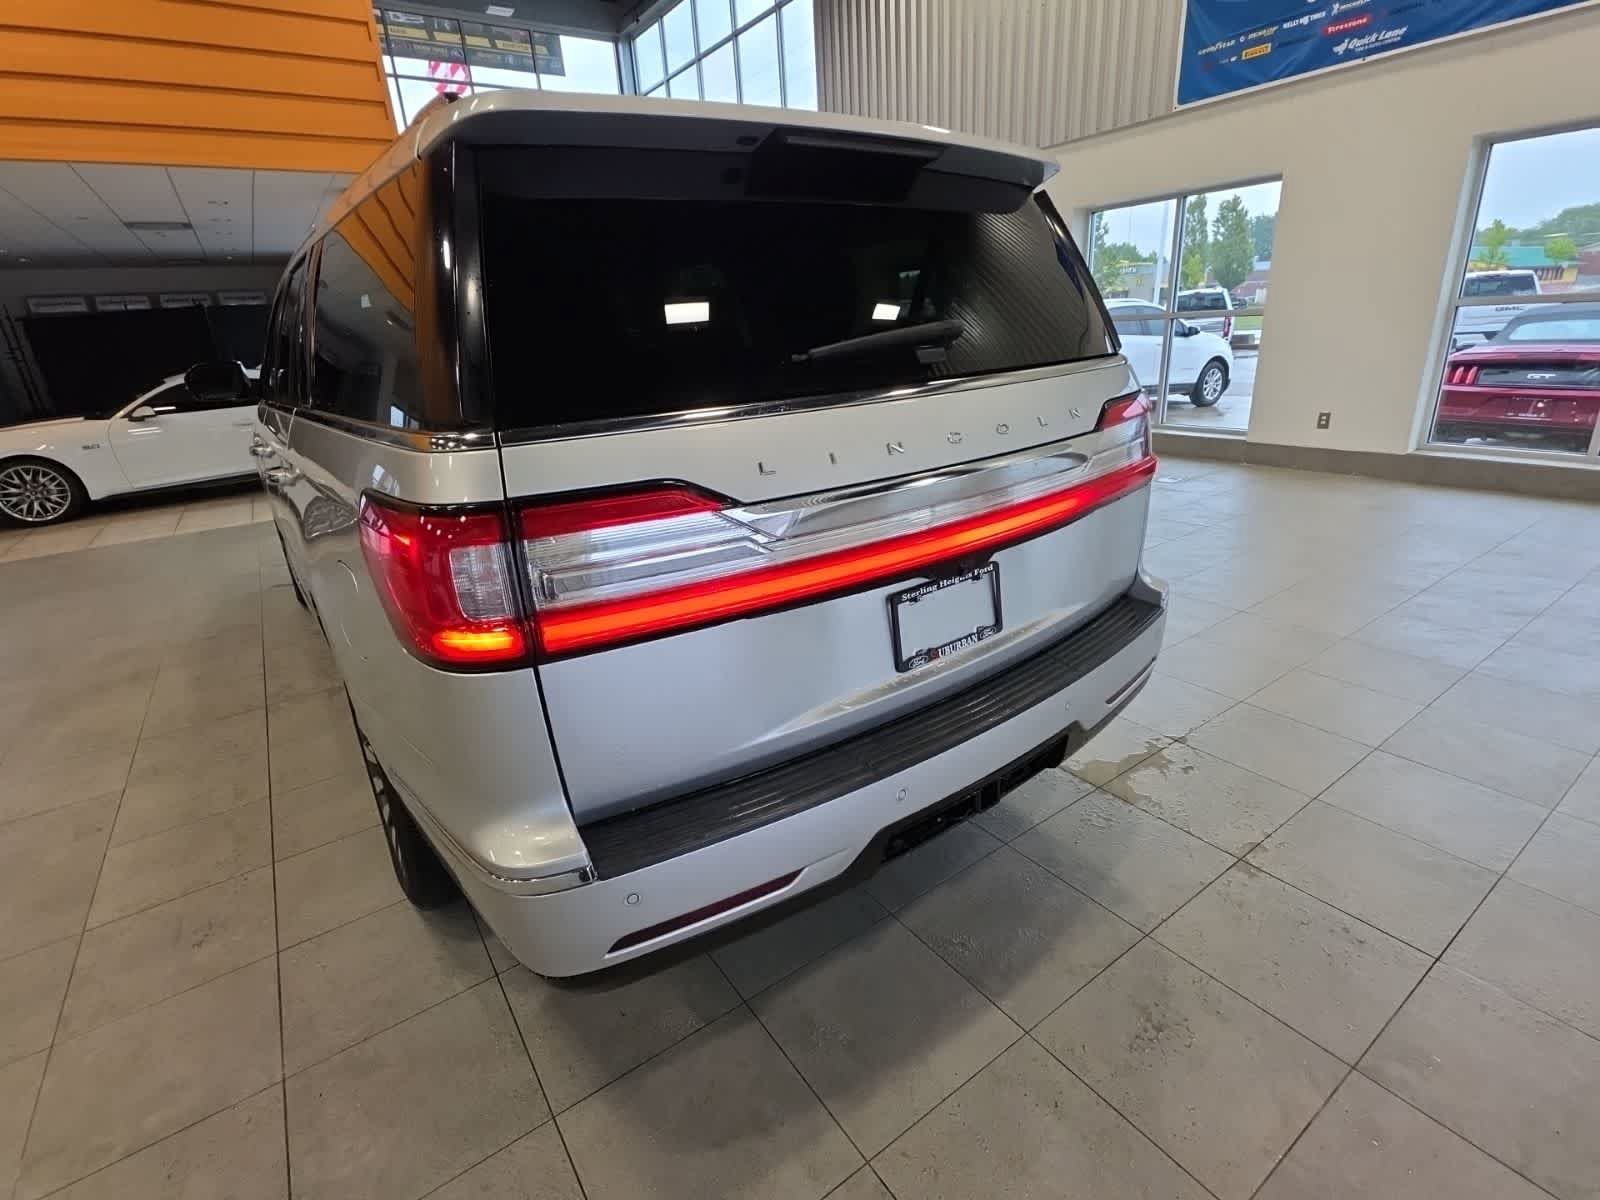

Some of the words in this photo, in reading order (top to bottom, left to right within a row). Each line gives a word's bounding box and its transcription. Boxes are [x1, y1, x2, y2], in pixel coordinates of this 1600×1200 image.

[1348, 33, 1378, 49] Quick
[757, 407, 1081, 476] LINCOLN
[901, 583, 938, 601] Sterling
[939, 572, 973, 588] Heigs
[974, 563, 994, 576] Ford
[931, 633, 978, 658] SUBURBAN
